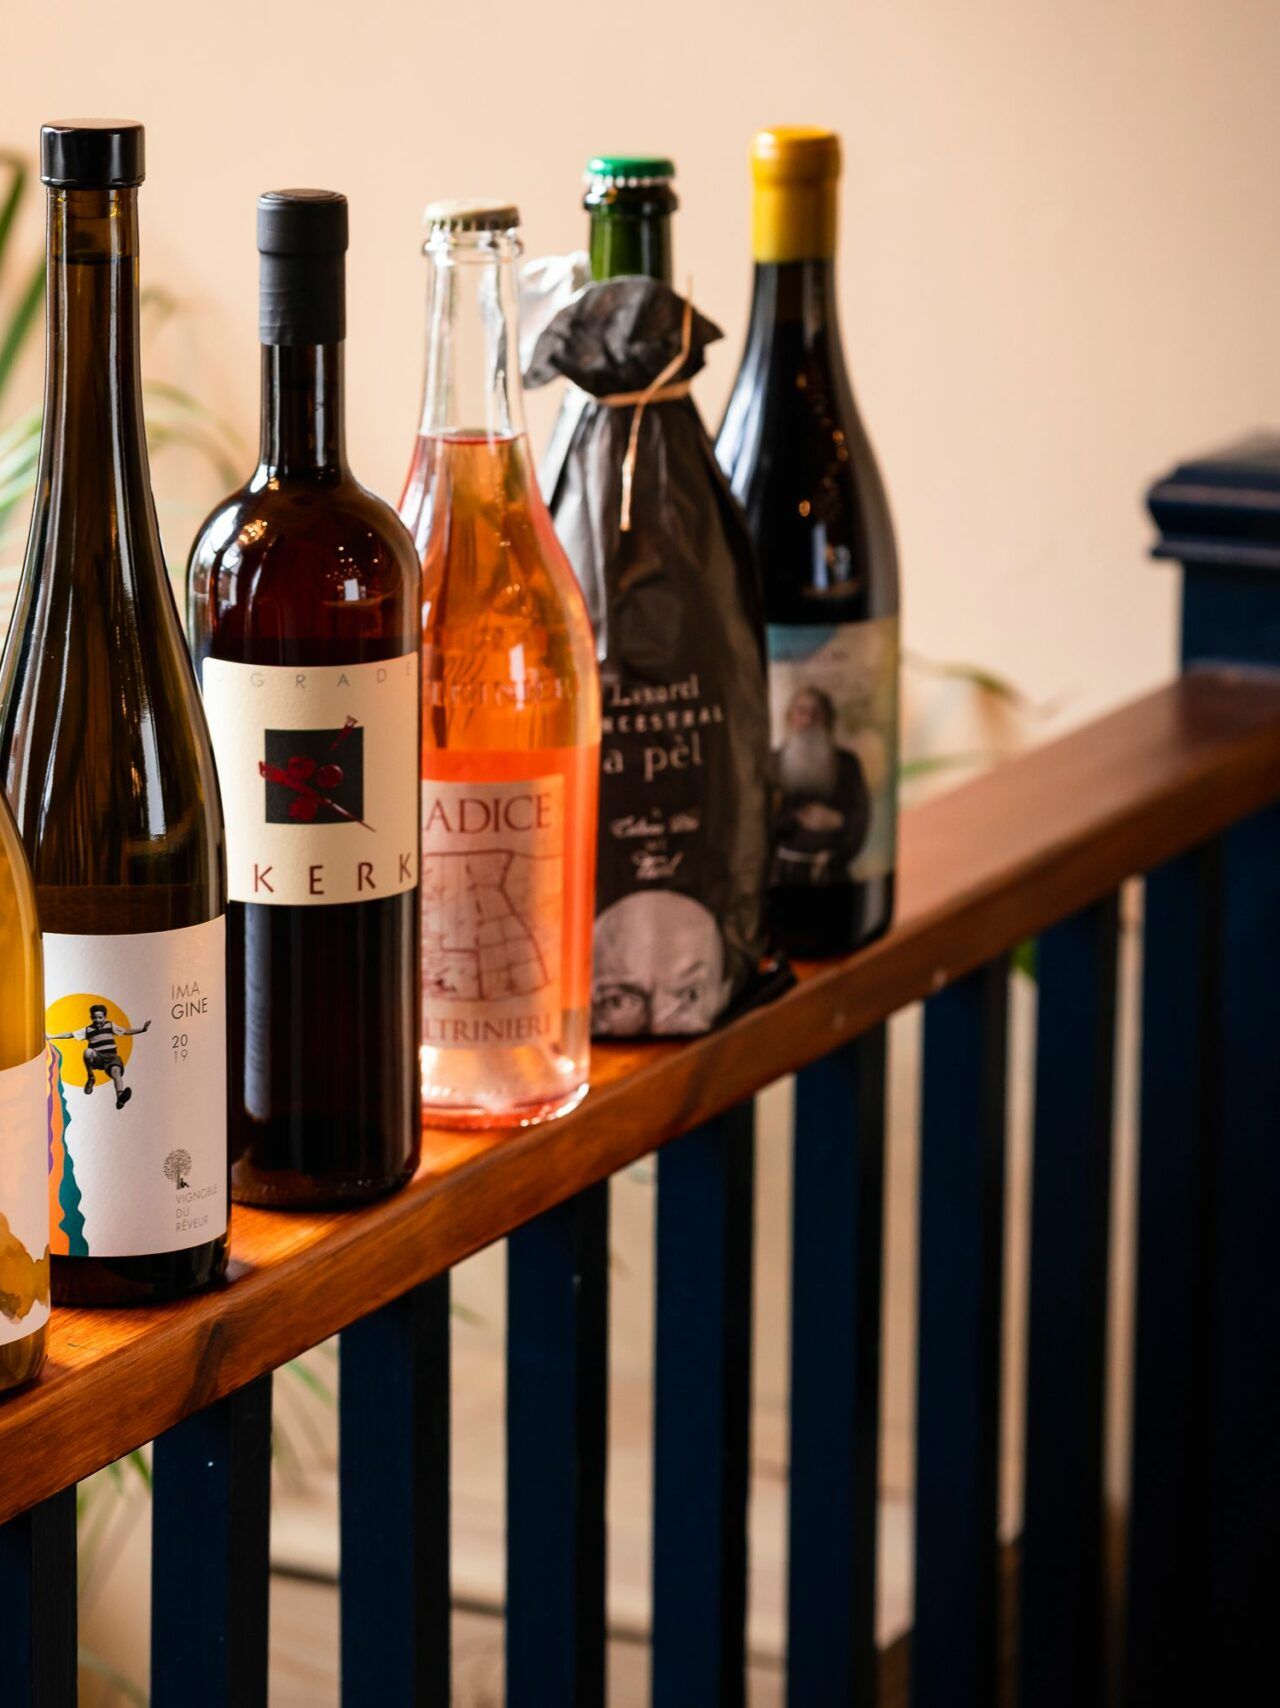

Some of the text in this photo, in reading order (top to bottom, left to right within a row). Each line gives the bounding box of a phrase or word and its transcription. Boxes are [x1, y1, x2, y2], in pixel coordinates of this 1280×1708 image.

[602, 748, 624, 775] a
[254, 852, 412, 895] KERK
[171, 981, 201, 1000] IMA
[171, 997, 209, 1021] GINE
[172, 1033, 189, 1049] 20
[173, 1049, 189, 1064] 19
[175, 1206, 190, 1219] DU
